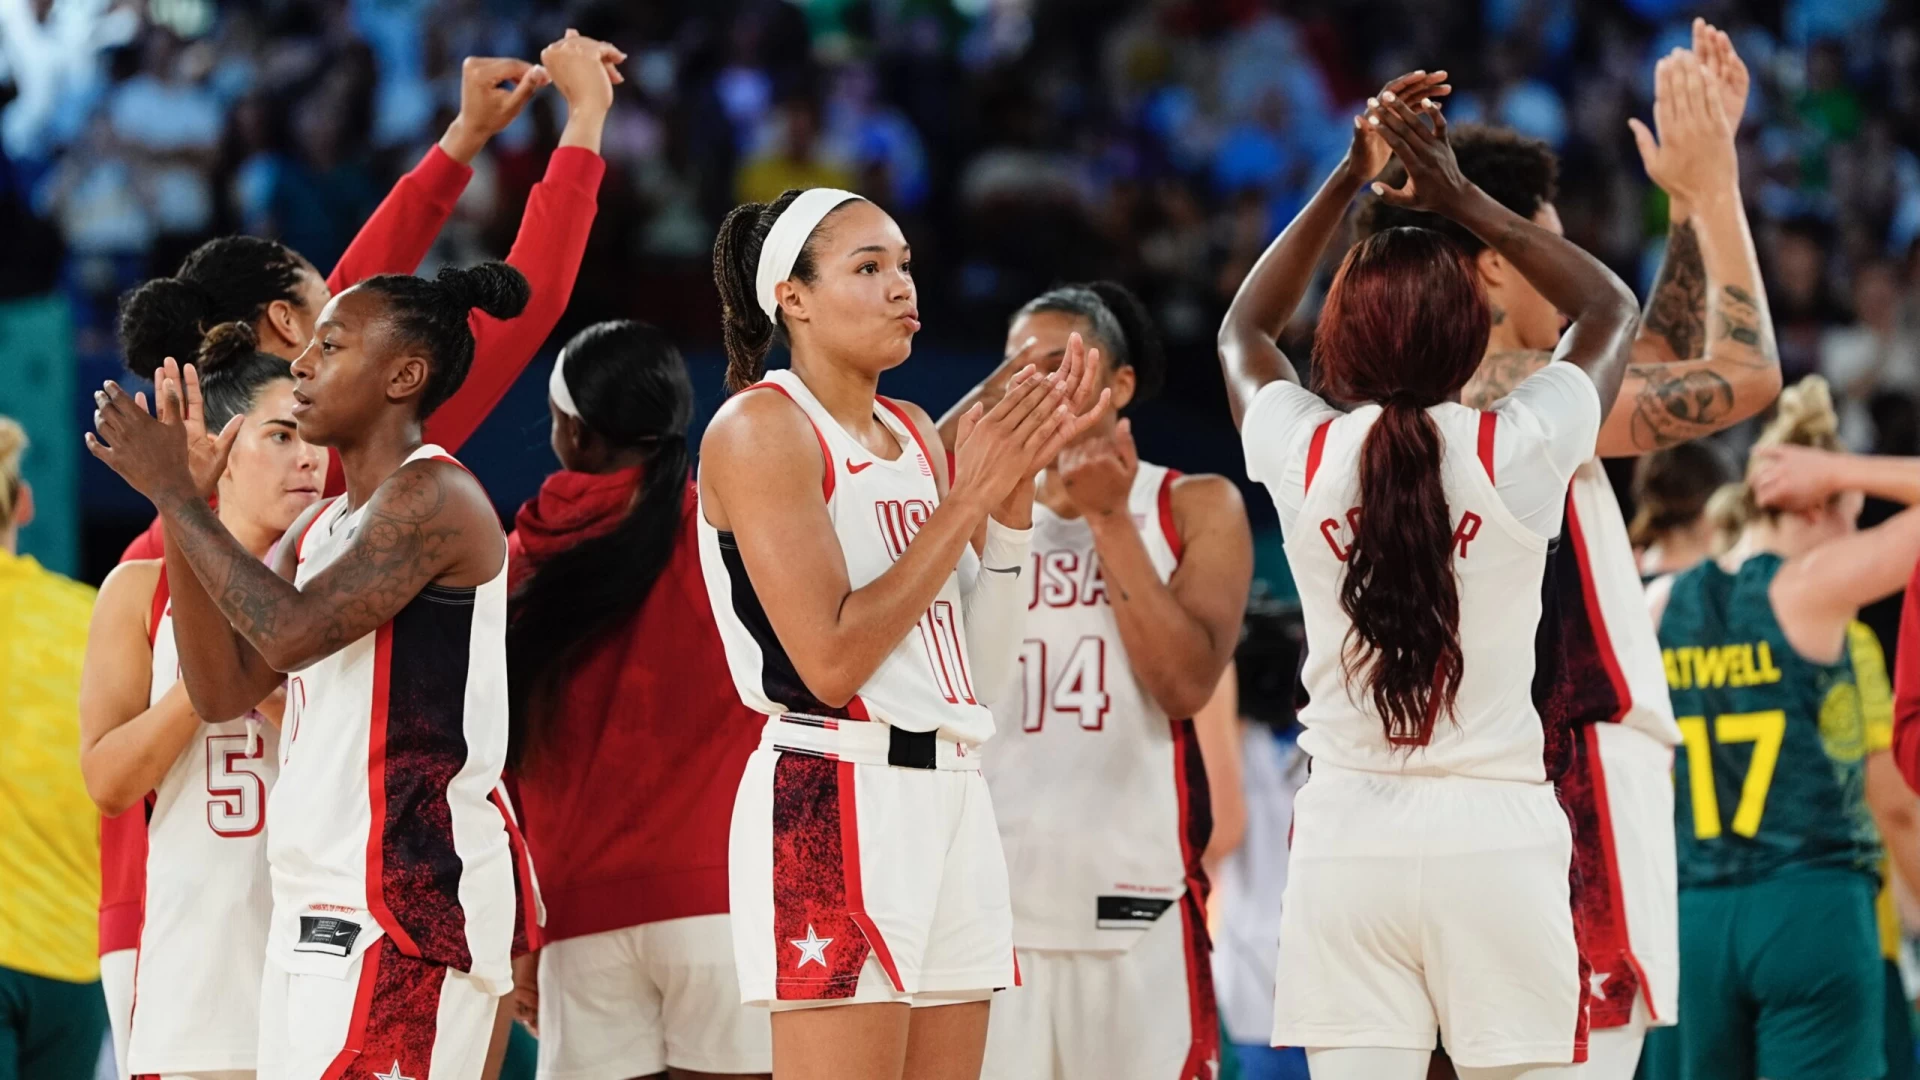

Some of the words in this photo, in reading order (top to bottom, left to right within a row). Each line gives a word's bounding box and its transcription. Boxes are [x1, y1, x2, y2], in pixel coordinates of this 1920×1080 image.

[1018, 635, 1110, 733] 14
[206, 734, 266, 838] 5
[1676, 709, 1786, 840] 17
